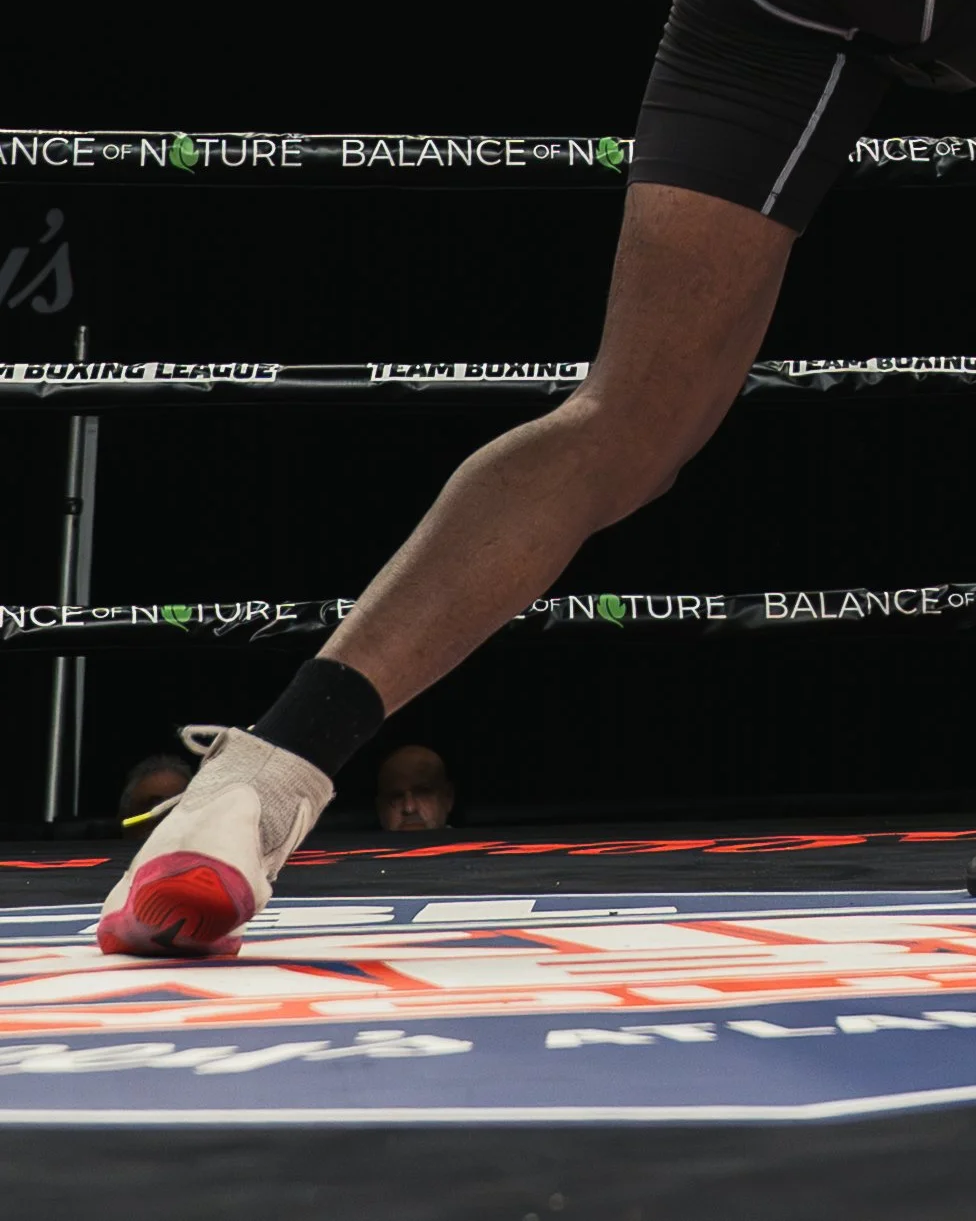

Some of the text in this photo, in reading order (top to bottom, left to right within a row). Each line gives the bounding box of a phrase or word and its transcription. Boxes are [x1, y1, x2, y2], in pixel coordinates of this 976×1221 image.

[103, 144, 132, 160] OF
[342, 139, 526, 167] BALANCE
[533, 144, 561, 159] OF
[936, 141, 960, 156] OF
[24, 364, 146, 379] BOXING
[155, 364, 280, 379] LEAGUE
[367, 363, 578, 379] TEAM BOXING
[786, 358, 867, 375] TEAM
[532, 598, 561, 611] OF
[764, 588, 942, 619] BALANCE
[948, 593, 975, 607] OF
[92, 607, 122, 618] OF
